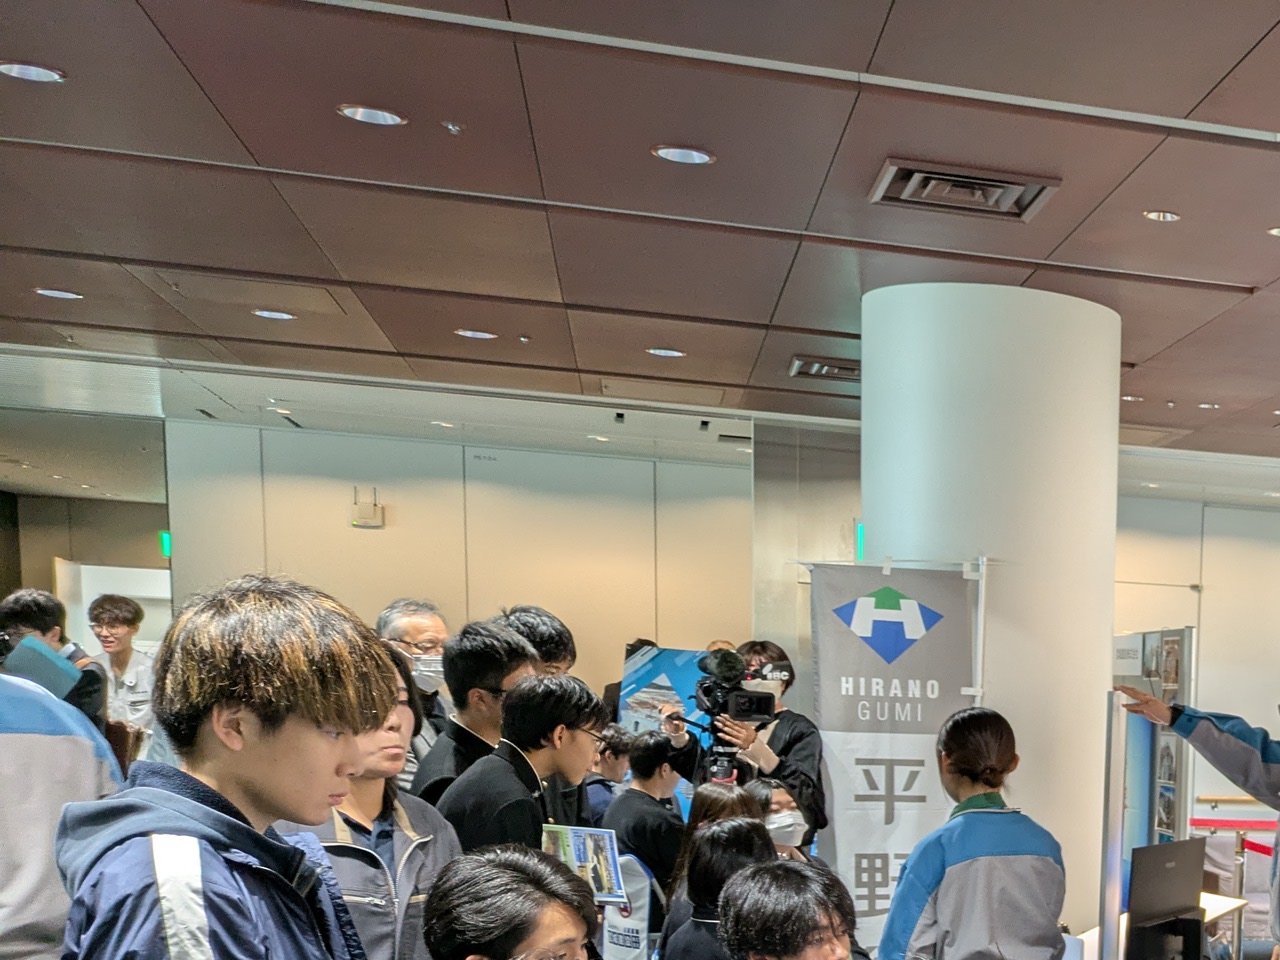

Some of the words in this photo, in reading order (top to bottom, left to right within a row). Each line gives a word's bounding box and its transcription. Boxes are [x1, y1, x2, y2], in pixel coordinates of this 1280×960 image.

[841, 676, 940, 699] HIRANO
[857, 700, 922, 722] GUMI
[854, 758, 927, 945] 平野
